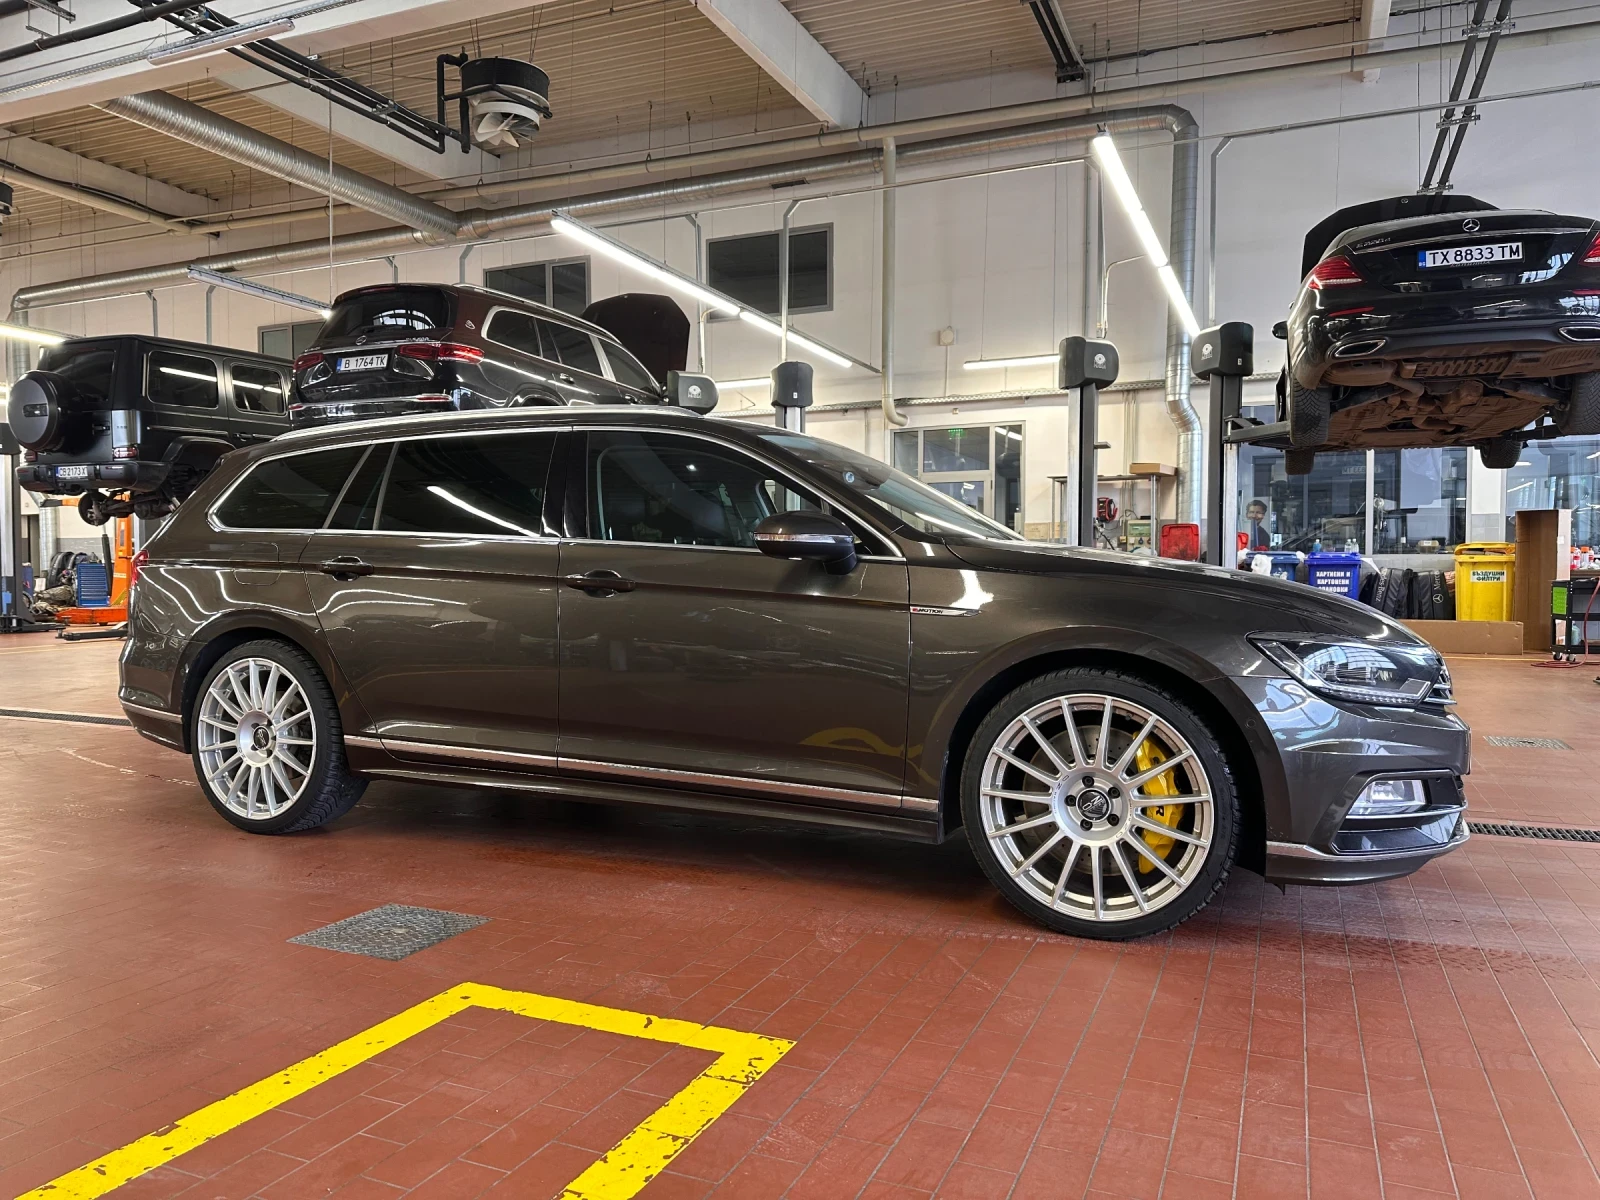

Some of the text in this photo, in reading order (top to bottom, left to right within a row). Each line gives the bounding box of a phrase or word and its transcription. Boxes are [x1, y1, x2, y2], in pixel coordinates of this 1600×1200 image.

[1429, 244, 1520, 265] TX 8833 TM
[344, 355, 387, 369] B 1764 TK
